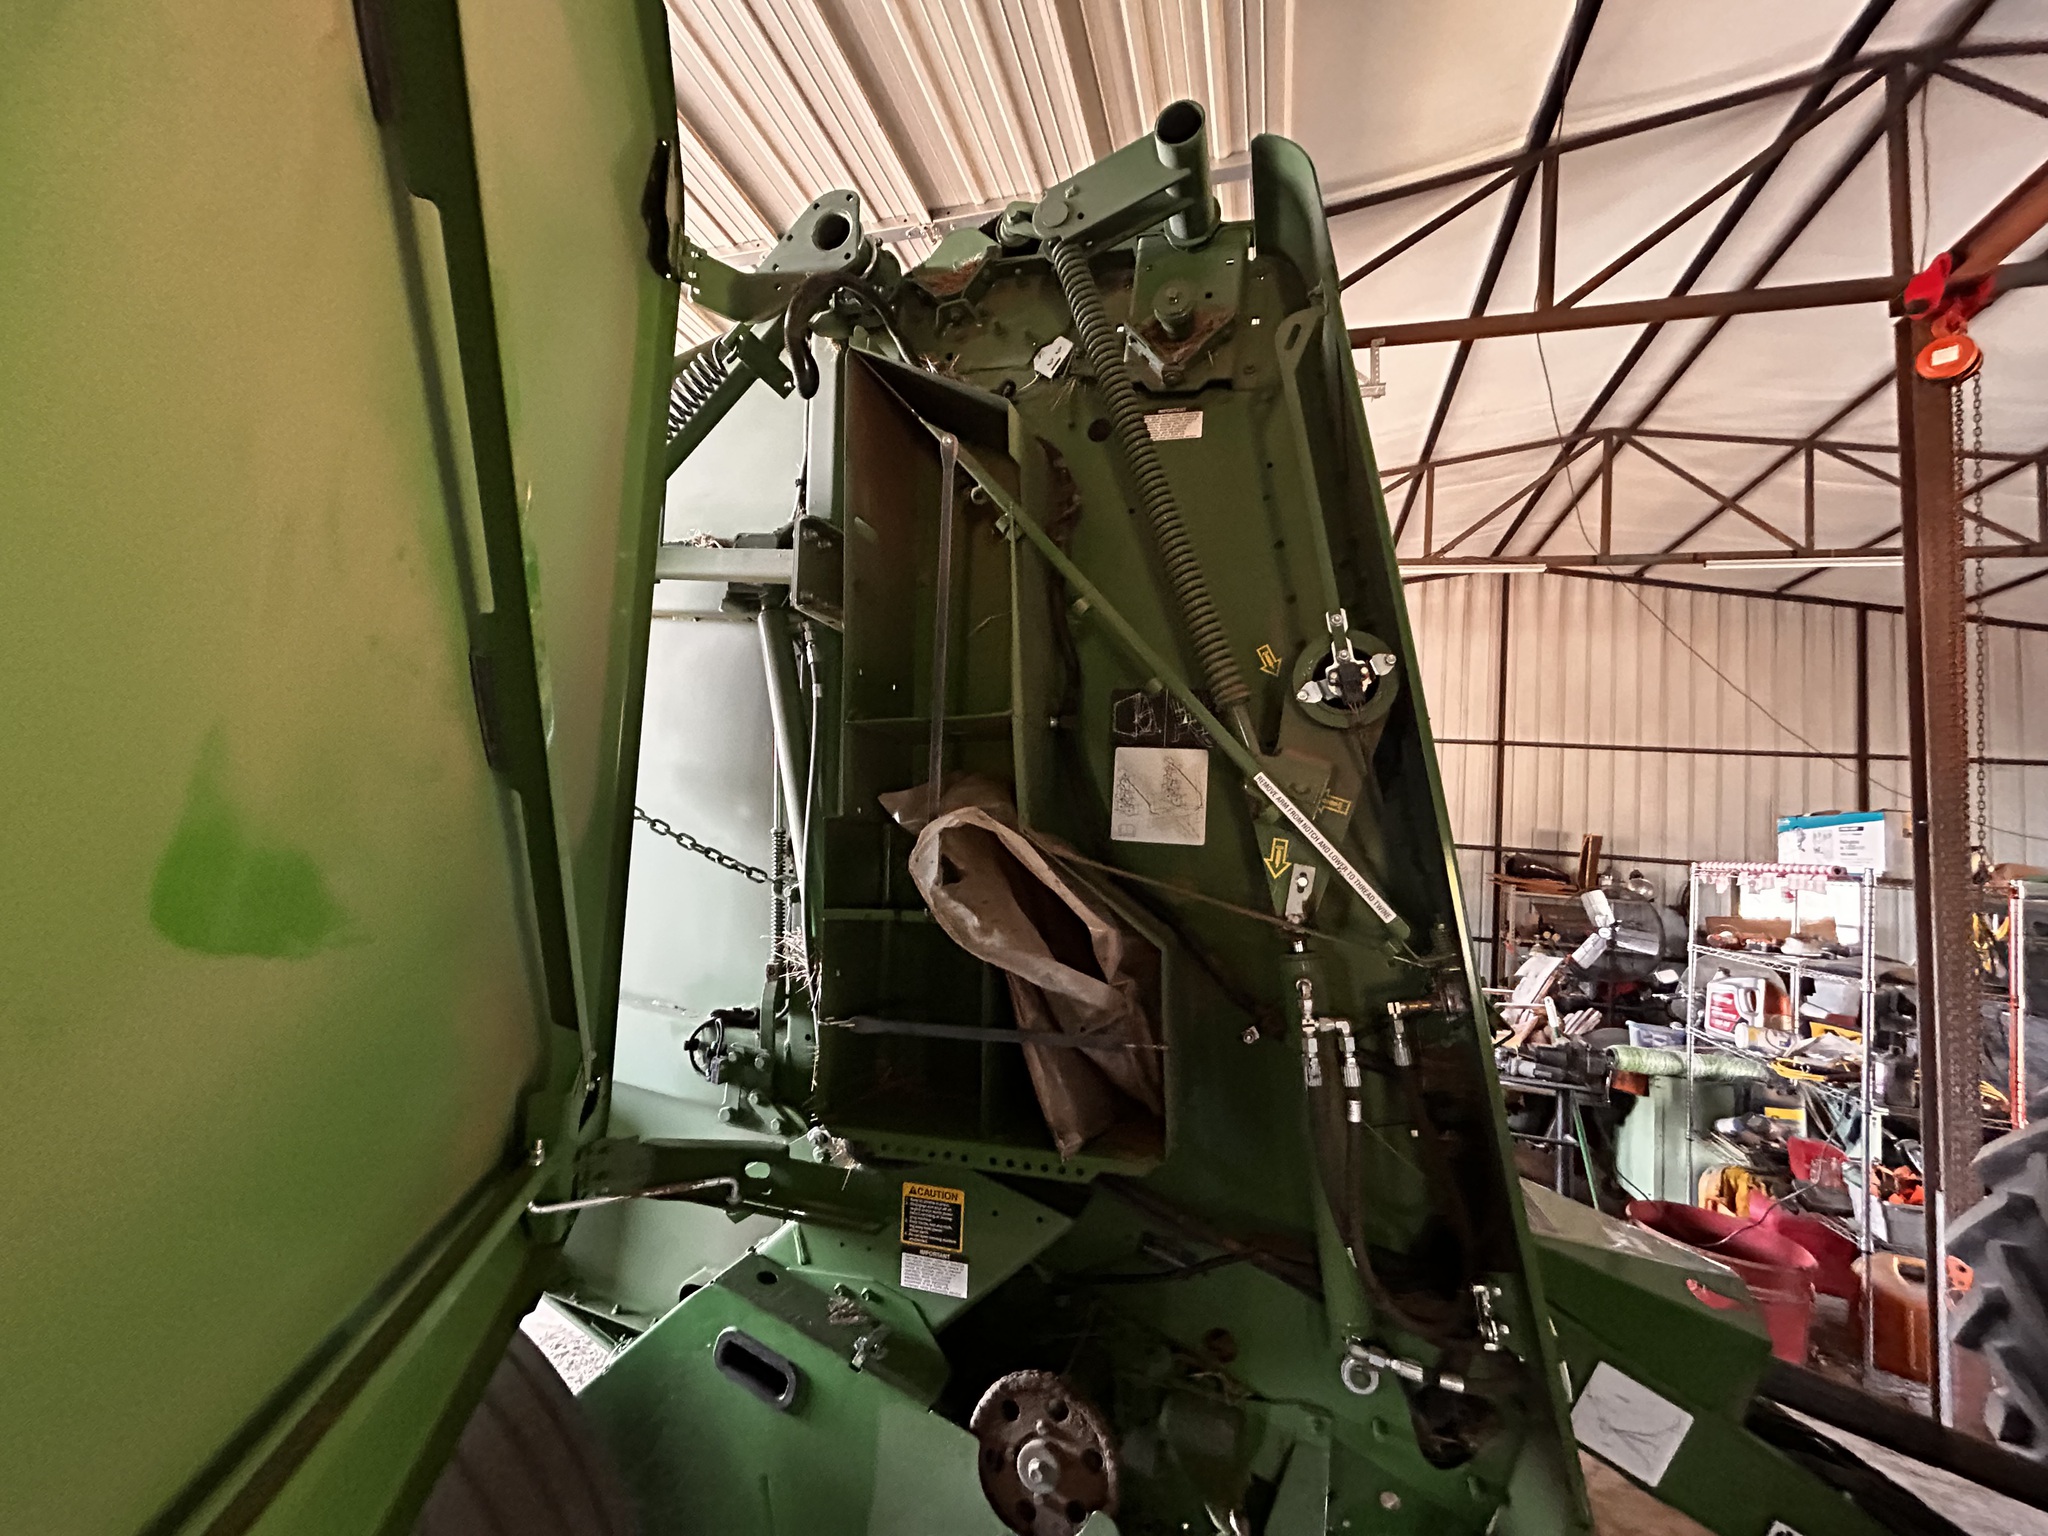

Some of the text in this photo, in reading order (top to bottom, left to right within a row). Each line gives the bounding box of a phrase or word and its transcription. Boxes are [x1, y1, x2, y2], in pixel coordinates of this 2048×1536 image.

[1256, 775, 1393, 919] REMOVE ARM FROM NOTCH AND LOWER TO THREAD TWINE
[917, 1186, 959, 1201] CAUTION
[919, 1248, 951, 1259] IMPORTANT
